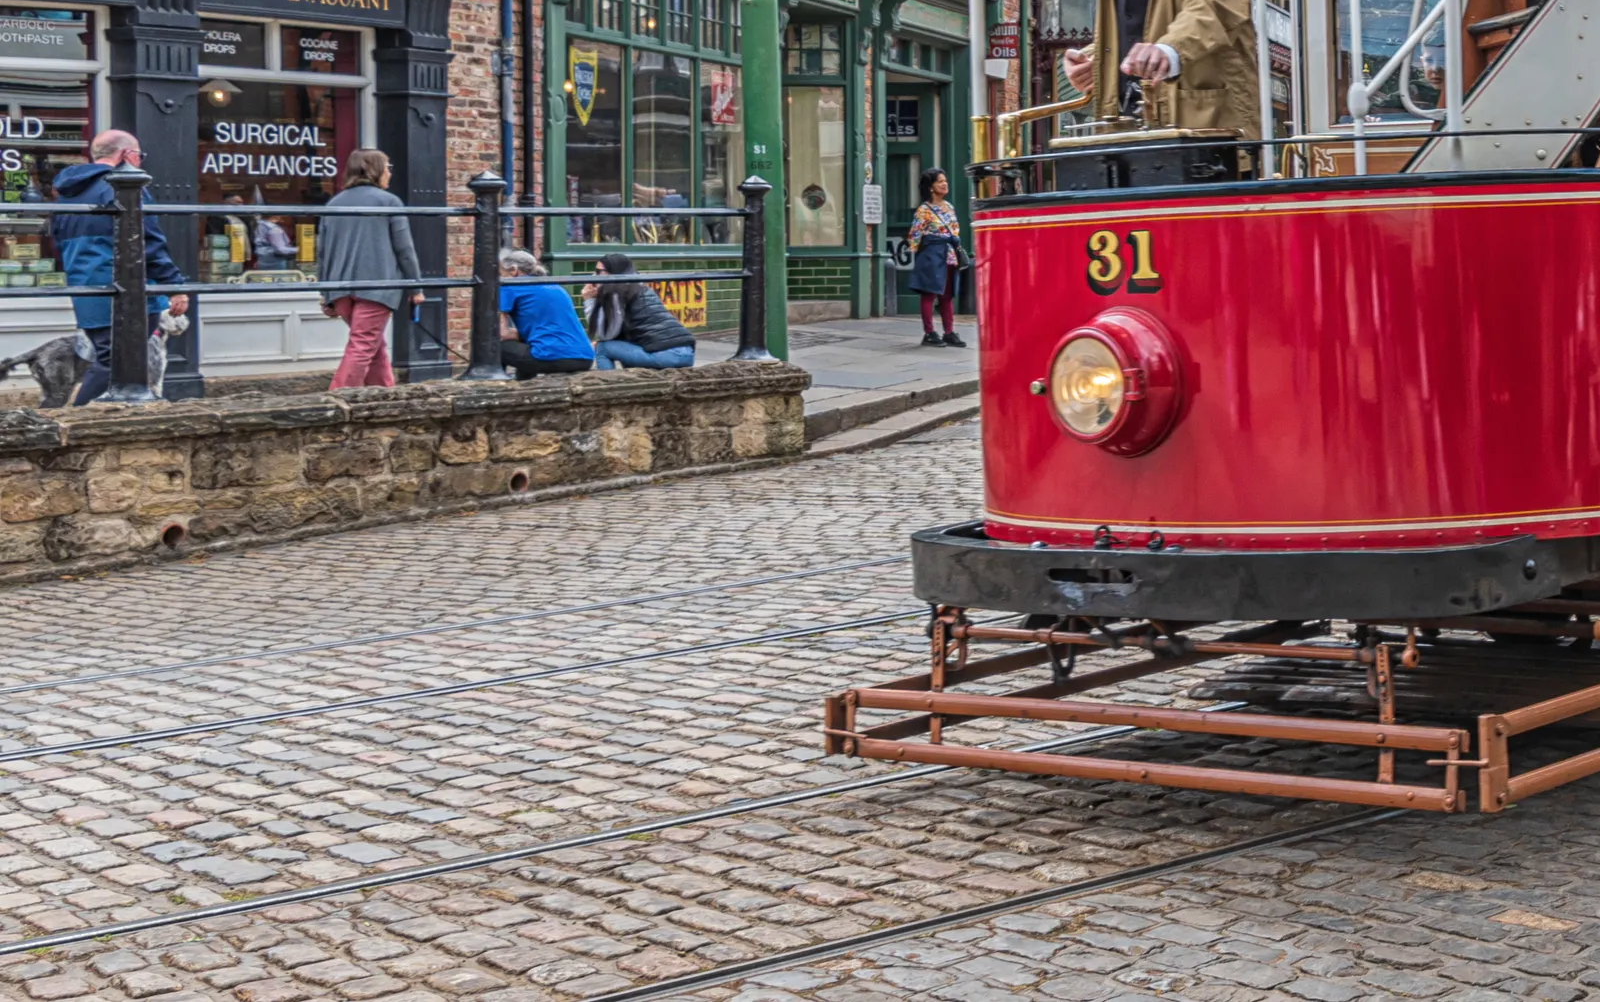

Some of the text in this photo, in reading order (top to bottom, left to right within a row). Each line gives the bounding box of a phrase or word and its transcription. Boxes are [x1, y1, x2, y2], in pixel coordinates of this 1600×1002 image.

[0, 18, 56, 31] ARBOLIC
[0, 32, 64, 45] OTHPASTE
[204, 30, 242, 43] HOLERA
[203, 43, 236, 55] DROPS
[300, 38, 338, 49] COCAINE
[304, 50, 335, 62] DROPS
[992, 46, 1017, 57] Oils
[215, 122, 327, 146] SURGICAL
[202, 153, 338, 177] APPLIANCES
[1086, 229, 1163, 295] 31
